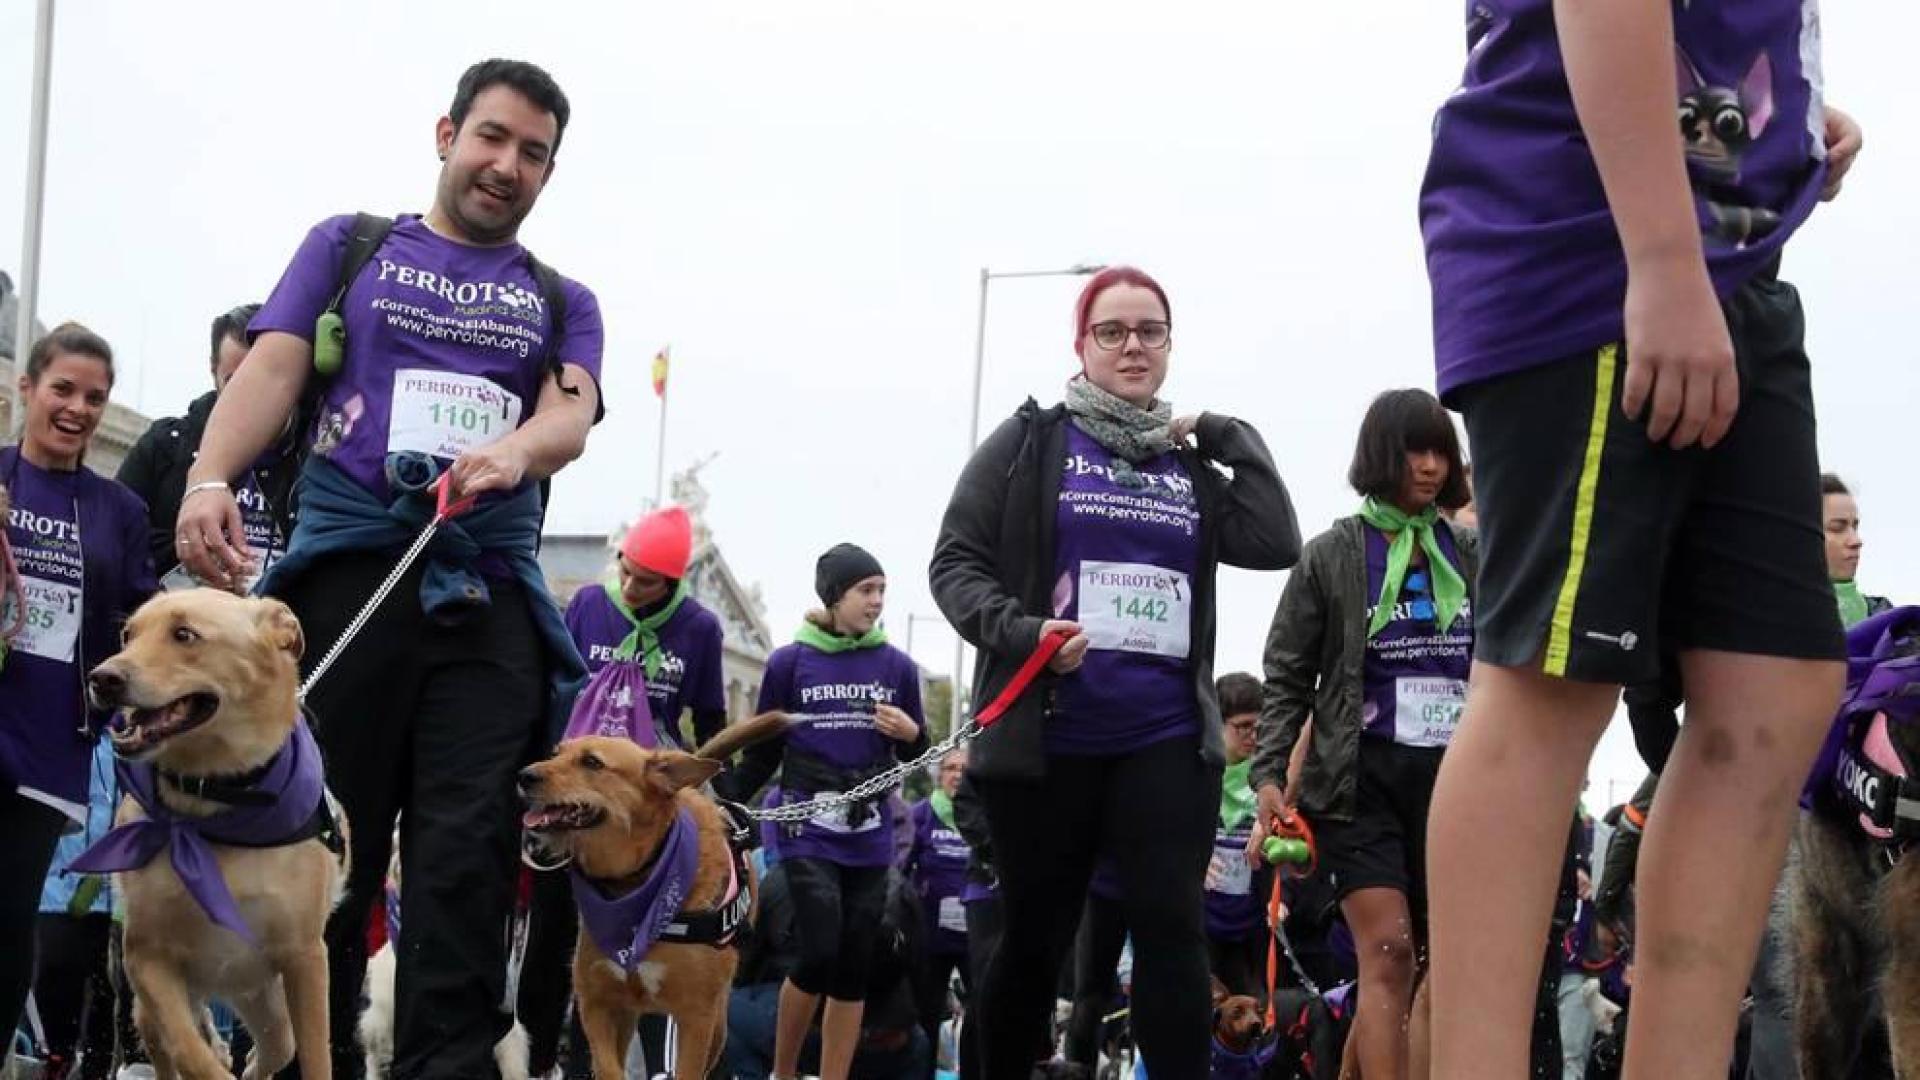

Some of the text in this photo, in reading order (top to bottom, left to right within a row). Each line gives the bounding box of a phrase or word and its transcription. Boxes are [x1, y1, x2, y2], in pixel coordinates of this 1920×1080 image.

[387, 313, 530, 358] www.perroton.org
[428, 402, 490, 435] 1101
[437, 443, 463, 457] Ado
[1111, 594, 1168, 622] 1442
